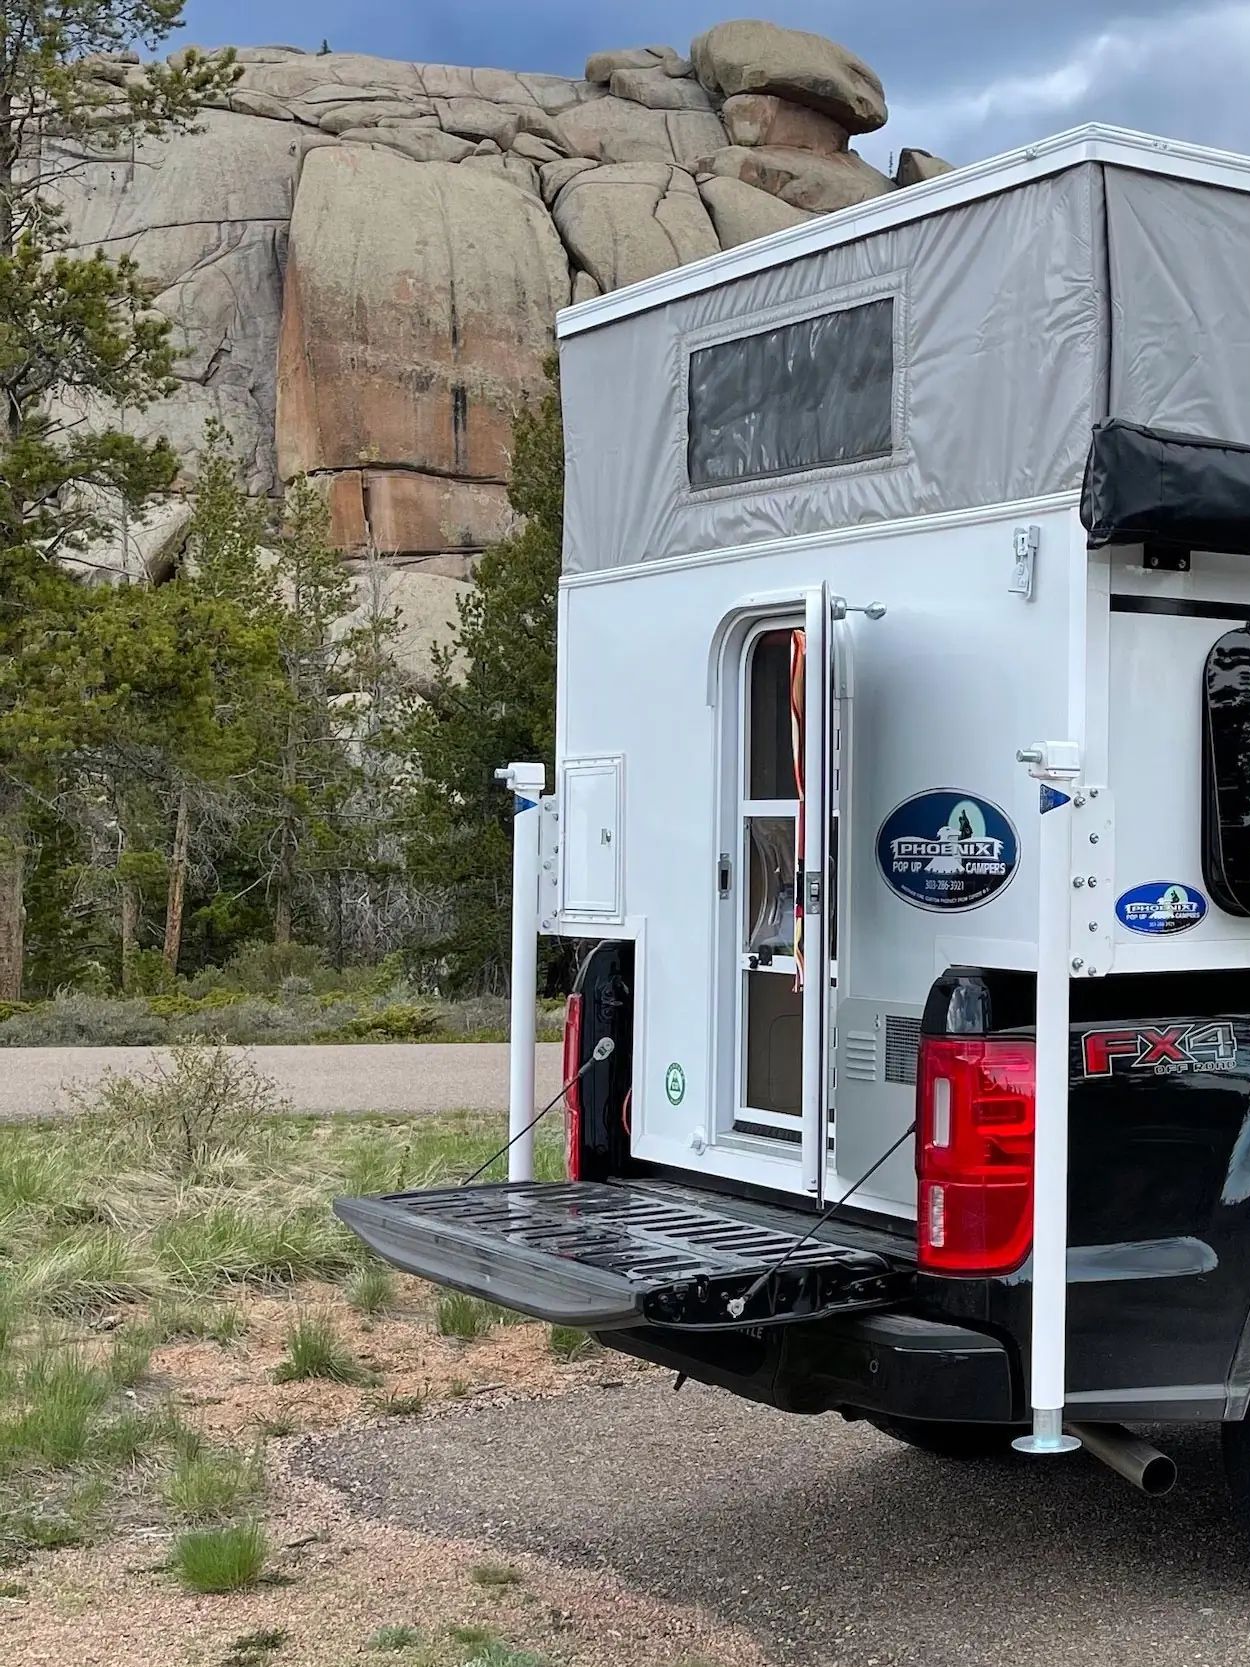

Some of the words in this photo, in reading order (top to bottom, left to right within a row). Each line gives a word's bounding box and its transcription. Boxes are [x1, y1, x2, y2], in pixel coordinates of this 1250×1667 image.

[900, 843, 992, 856] PHOENIX
[892, 861, 908, 873] POP
[911, 861, 922, 873] UP
[965, 861, 1006, 875] CAMPERS
[1131, 904, 1191, 912] PHOENIX
[1081, 1022, 1237, 1078] FX4
[1154, 1064, 1188, 1075] OFF
[1193, 1060, 1237, 1072] ROAD
